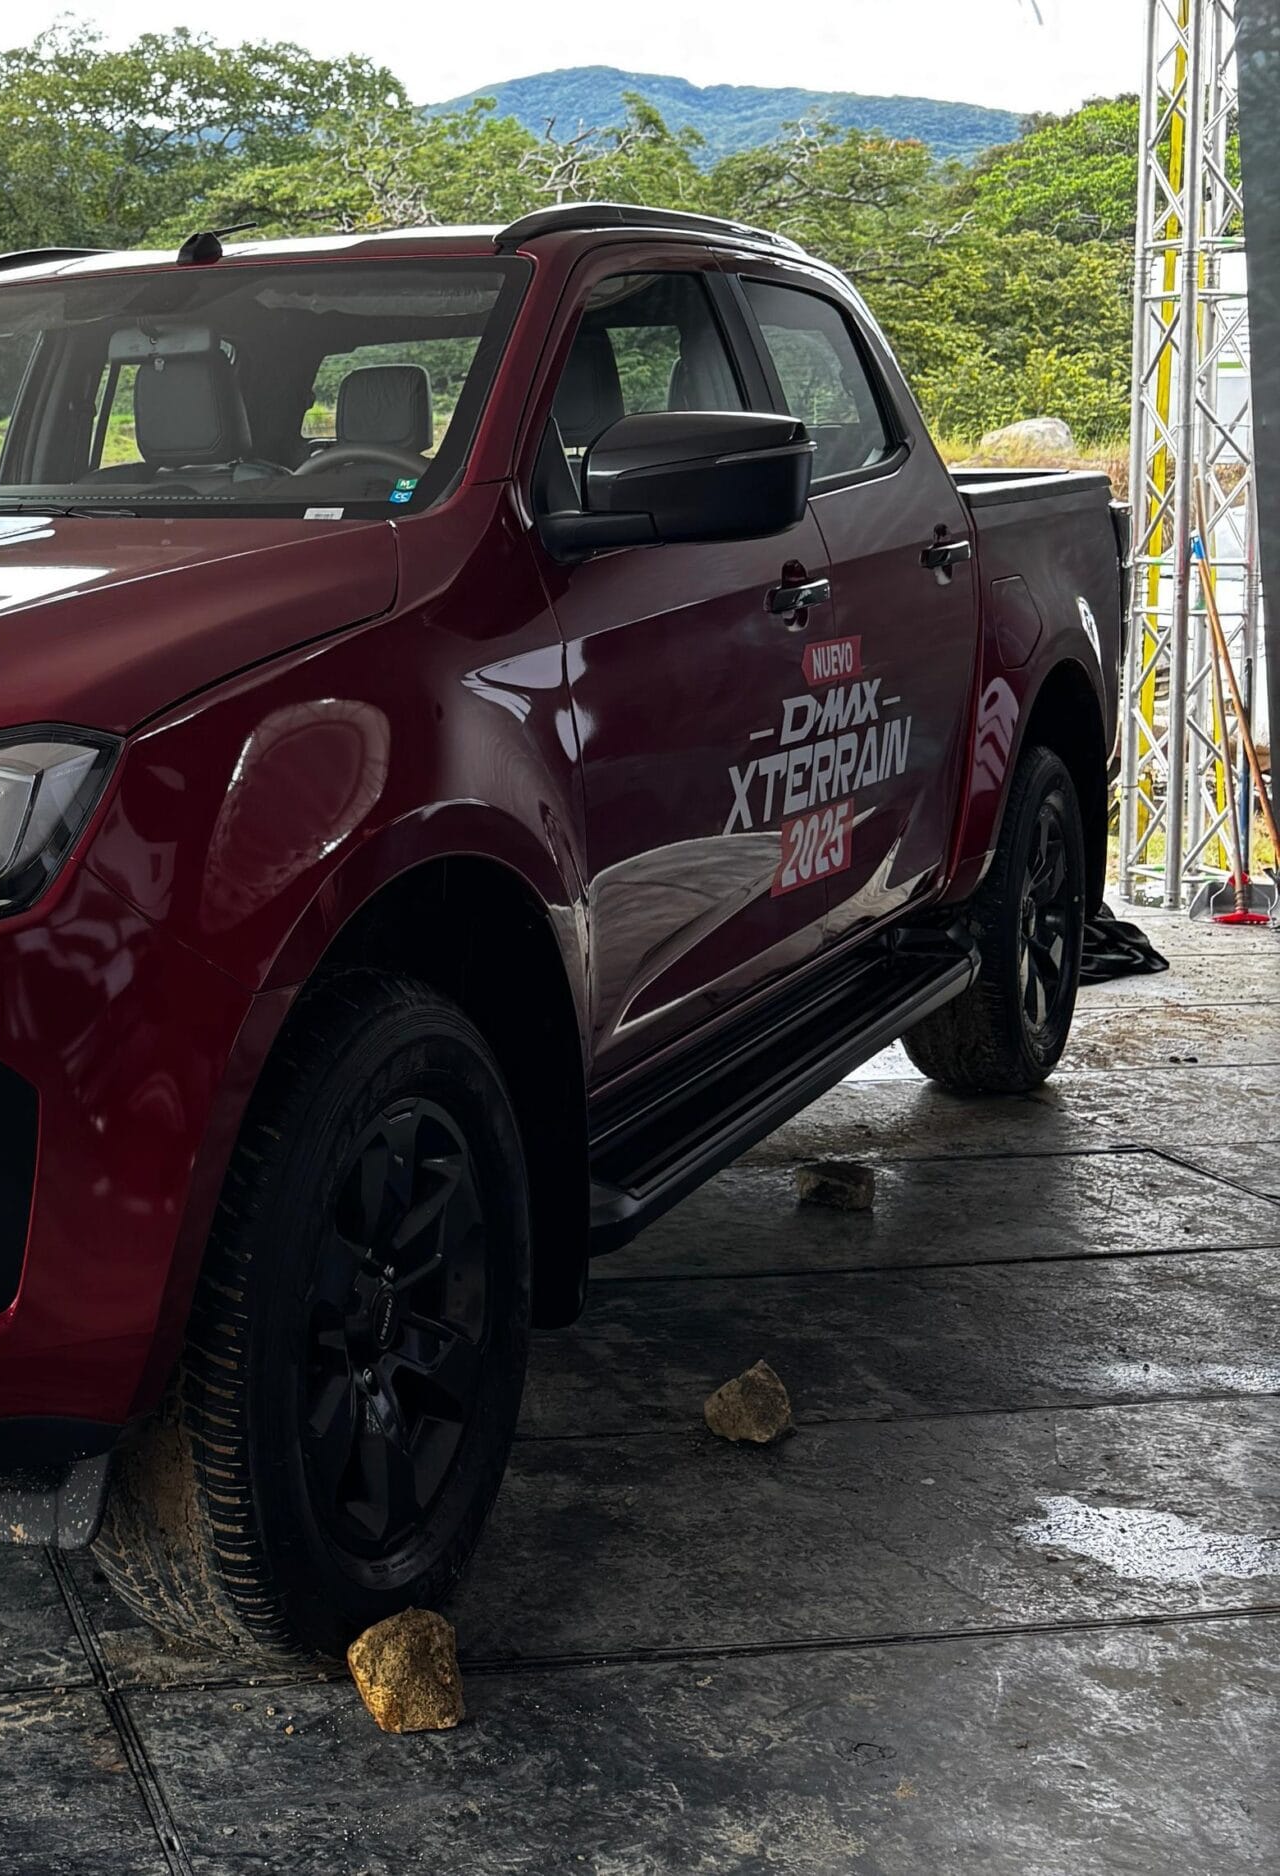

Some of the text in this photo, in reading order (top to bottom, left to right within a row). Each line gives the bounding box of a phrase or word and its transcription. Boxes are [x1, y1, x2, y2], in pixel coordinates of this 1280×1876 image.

[812, 641, 853, 681] NUEVO
[722, 715, 912, 836] XTERRAIN
[781, 802, 849, 888] 2025
